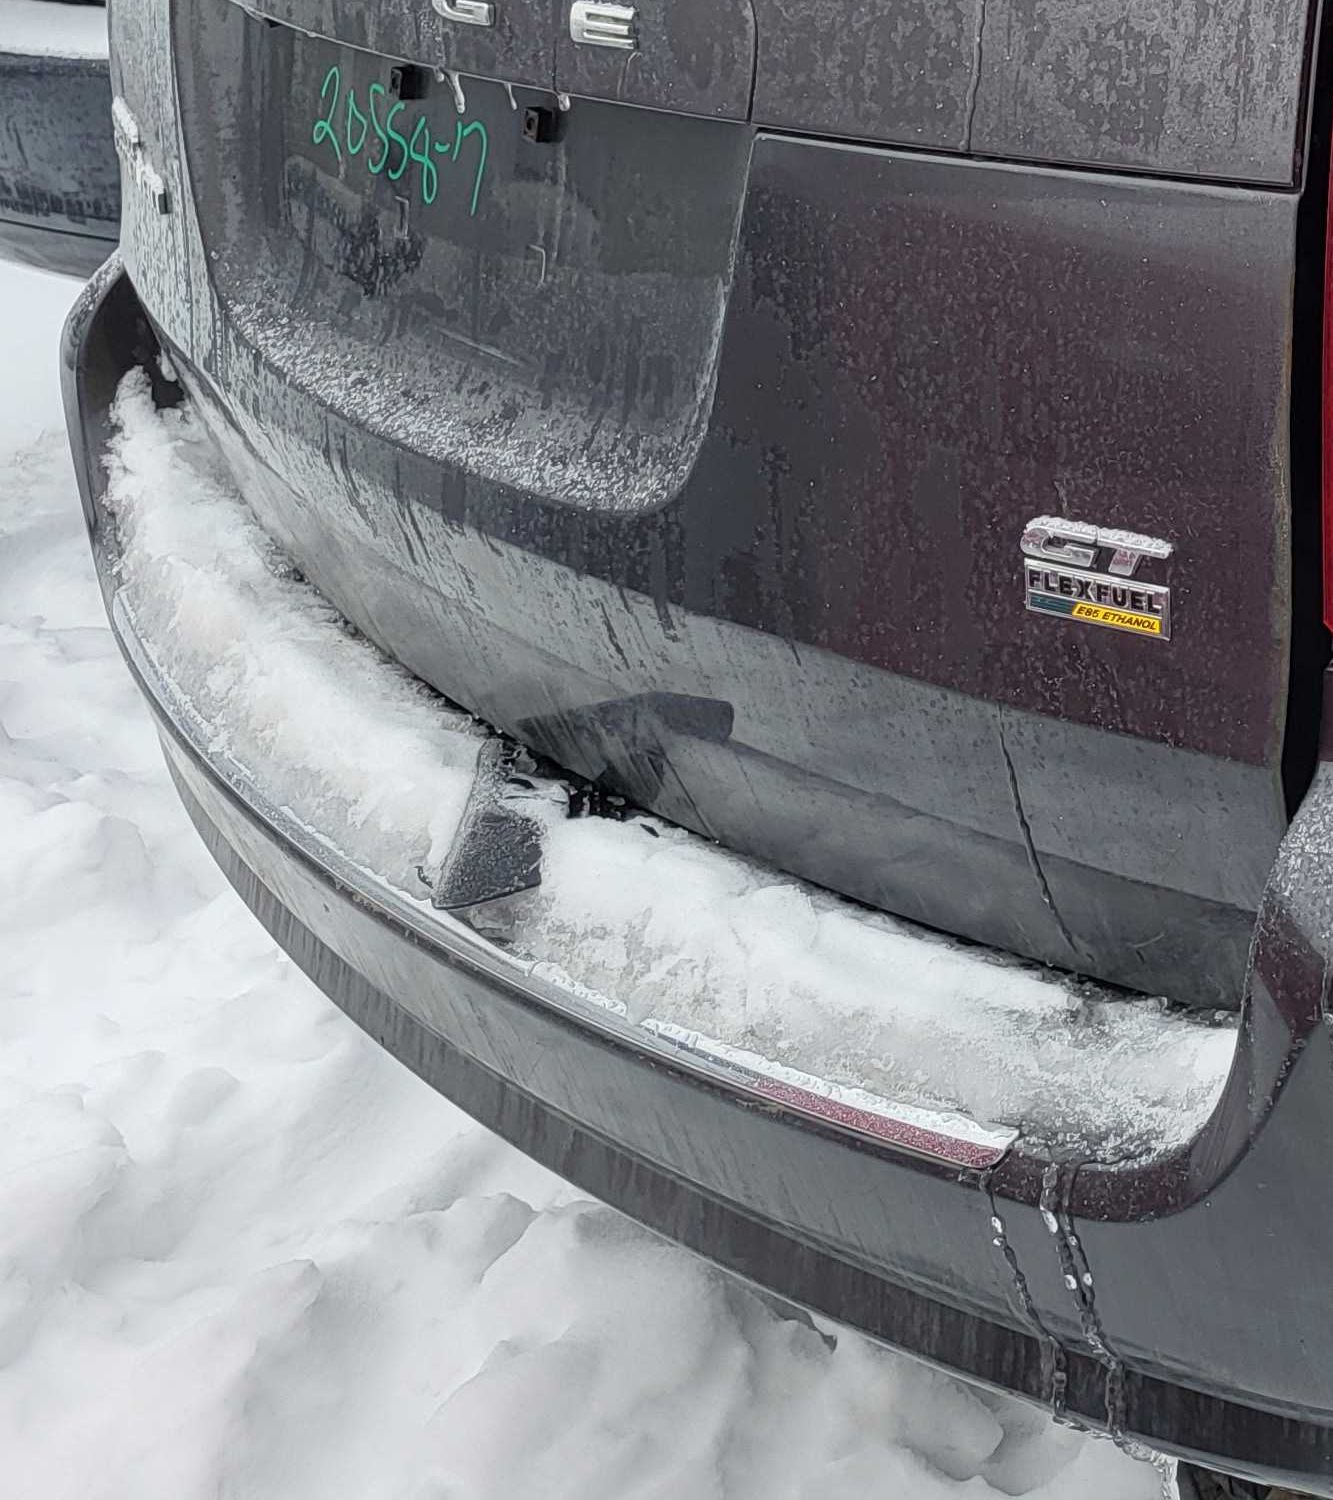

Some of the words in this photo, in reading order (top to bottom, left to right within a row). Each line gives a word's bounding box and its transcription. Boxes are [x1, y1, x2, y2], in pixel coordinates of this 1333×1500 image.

[1020, 517, 1174, 577] GT
[1076, 605, 1100, 619] E85
[1101, 611, 1157, 631] ETHANOL
